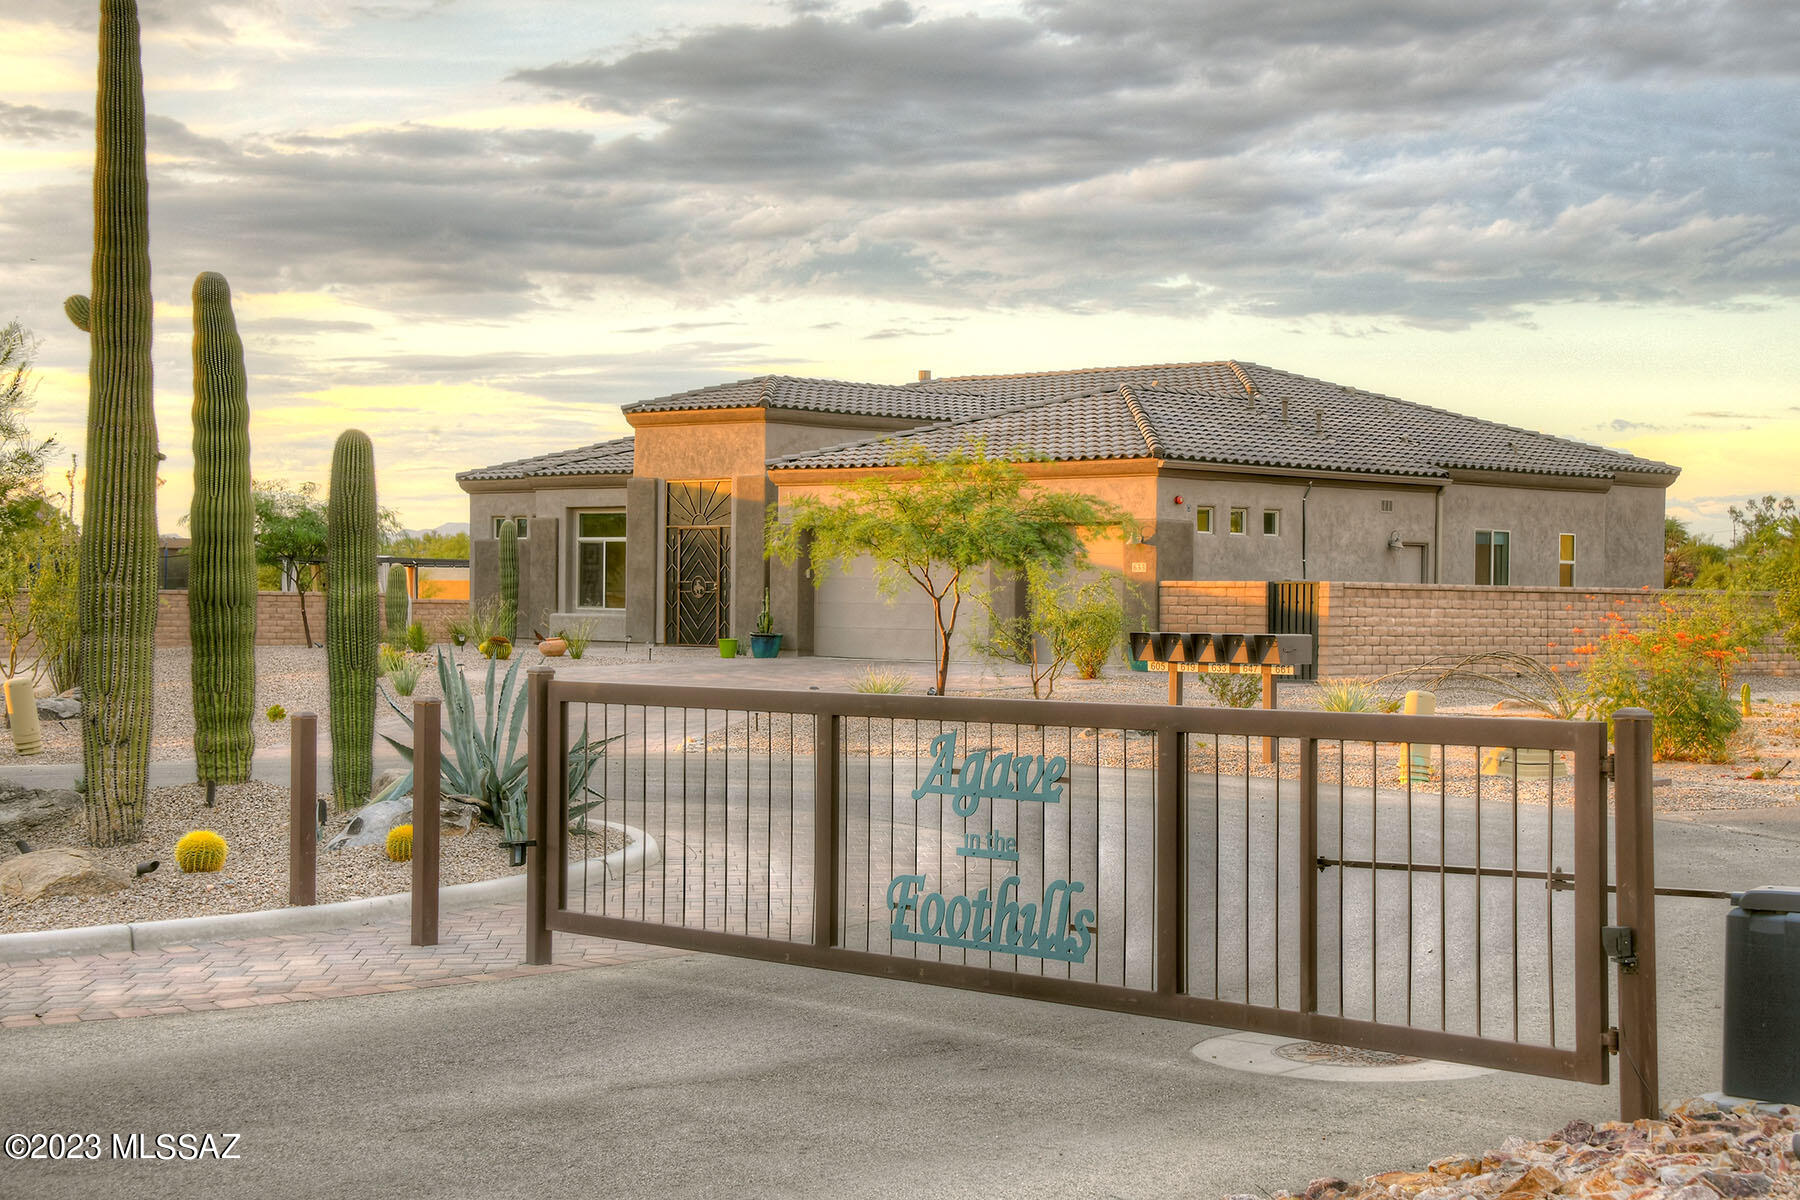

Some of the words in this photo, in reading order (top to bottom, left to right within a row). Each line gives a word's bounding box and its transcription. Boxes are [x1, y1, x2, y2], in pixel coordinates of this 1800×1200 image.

[1150, 661, 1166, 671] 605
[1180, 662, 1196, 671] 619
[1211, 663, 1227, 673] 633
[1242, 664, 1258, 673] 647
[1275, 664, 1291, 674] 661
[911, 728, 1066, 817] Agave
[963, 832, 981, 850] in
[986, 830, 1016, 852] the
[886, 873, 1095, 963] Foothills
